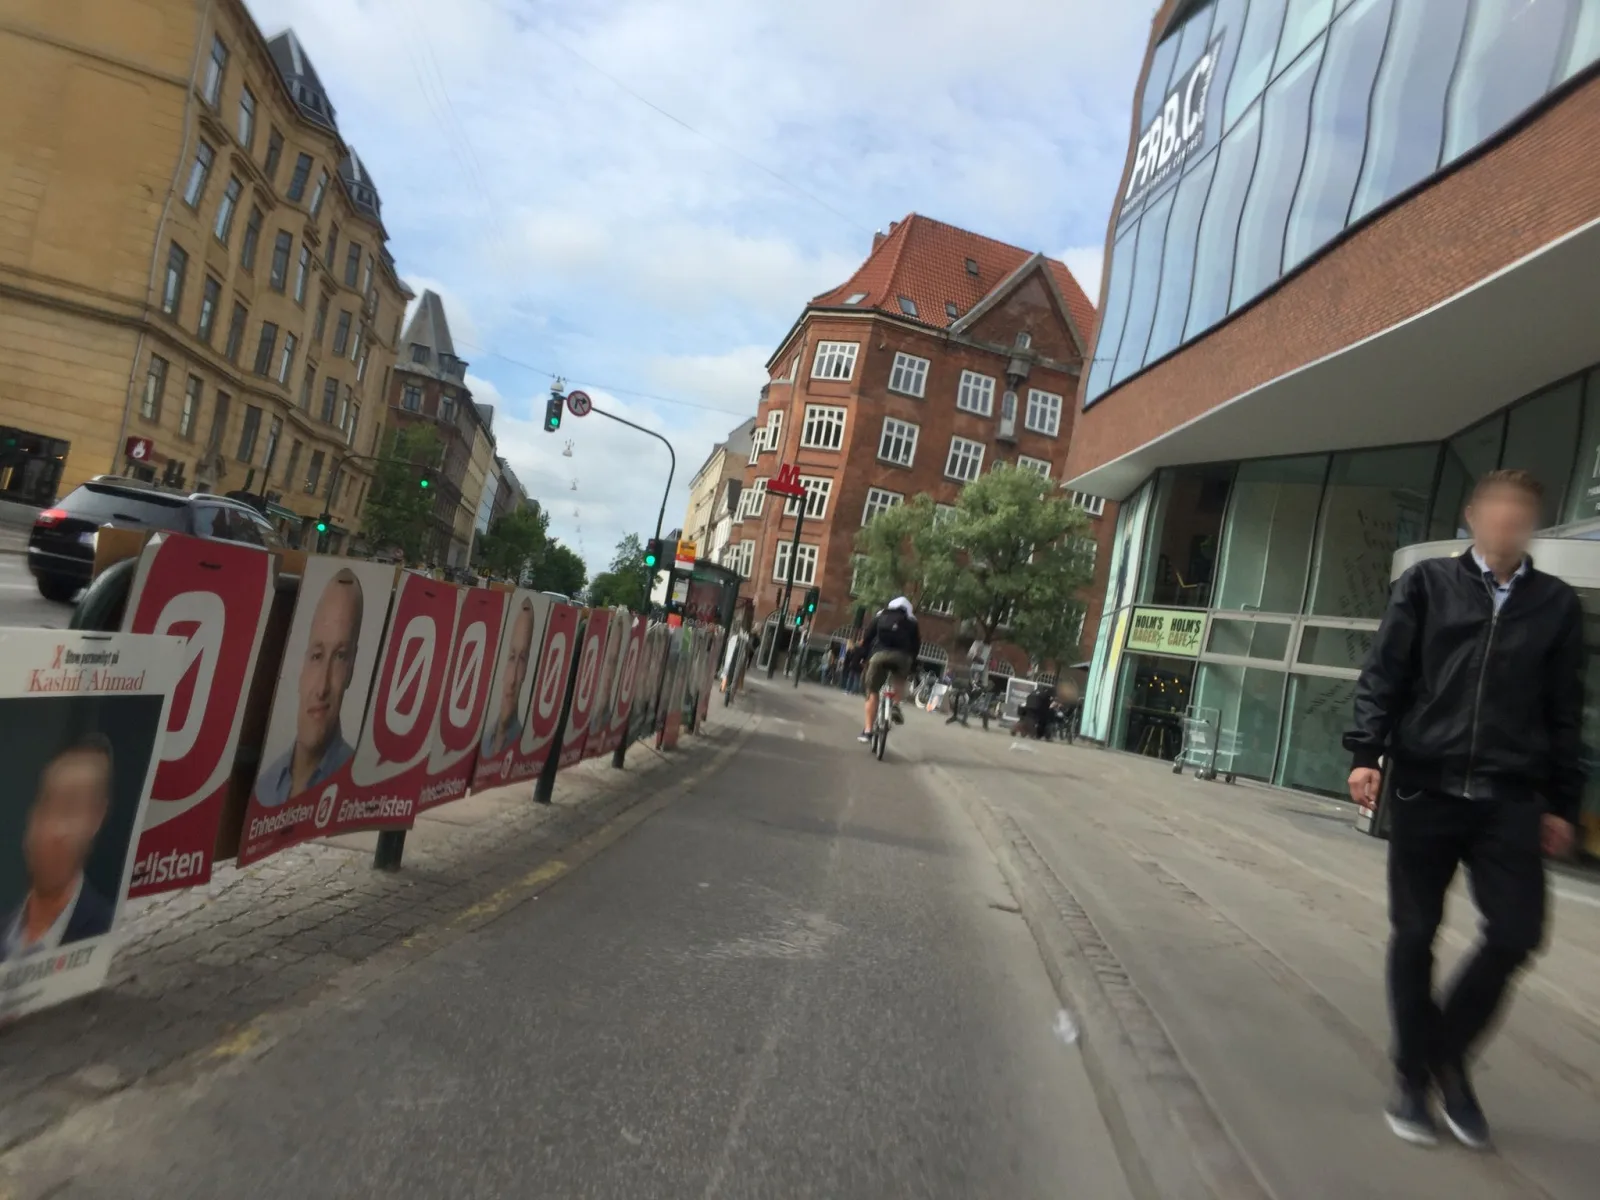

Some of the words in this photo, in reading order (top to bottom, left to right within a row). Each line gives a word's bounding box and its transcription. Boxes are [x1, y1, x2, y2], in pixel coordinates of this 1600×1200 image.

[1135, 615, 1164, 630] HOLM'S
[1170, 618, 1201, 634] HOLM'S
[28, 668, 87, 692] Kashif
[86, 669, 146, 692] Ahmad
[385, 615, 437, 736] Ø
[449, 621, 487, 728] Ø
[249, 803, 314, 840] Enhedslisten
